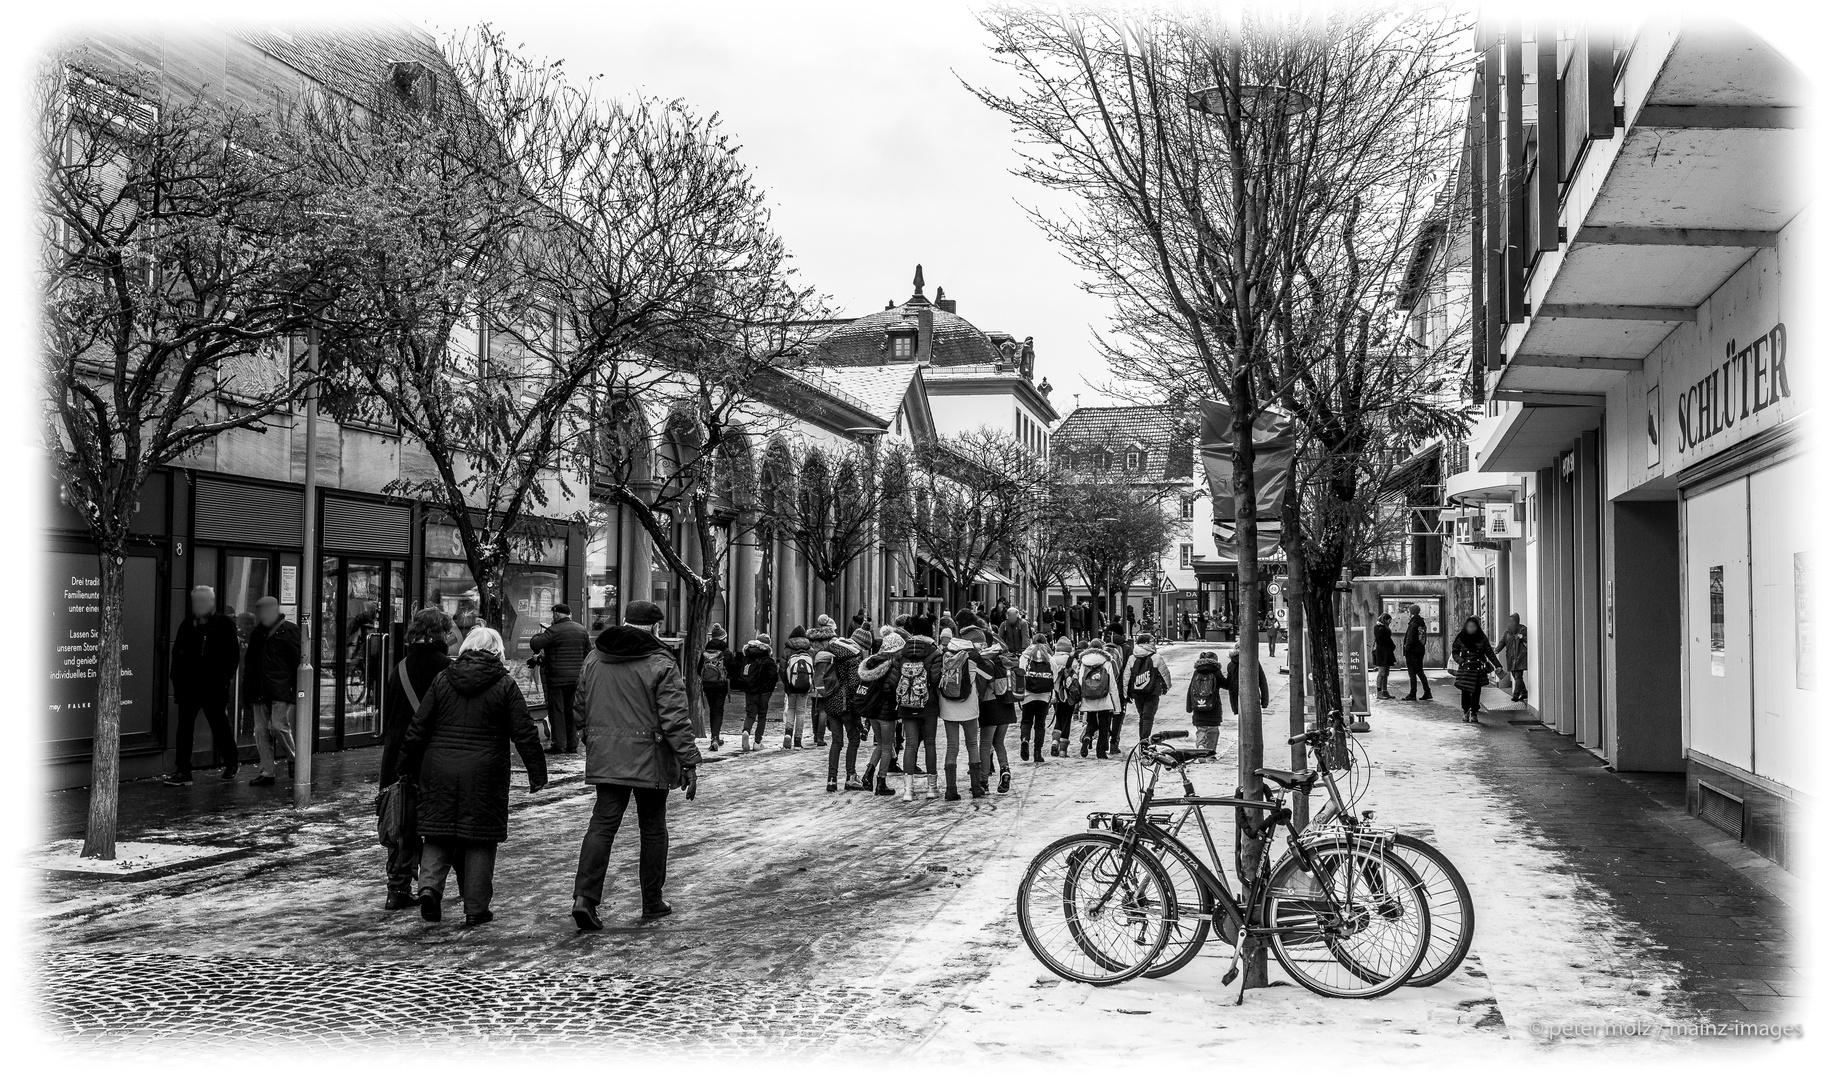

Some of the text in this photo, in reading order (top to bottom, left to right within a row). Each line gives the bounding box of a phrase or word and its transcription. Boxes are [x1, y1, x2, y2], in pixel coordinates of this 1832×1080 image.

[1678, 322, 1791, 454] SCHLÜTER
[176, 542, 183, 556] 8
[71, 576, 84, 586] Drei
[68, 604, 85, 613] unter
[69, 629, 90, 639] Lassen
[56, 644, 82, 653] unserem
[64, 654, 98, 668] und genieß
[49, 668, 87, 680] individuelles
[1135, 670, 1151, 686] NIKE
[67, 702, 91, 710] FALKE
[1161, 837, 1199, 870] SPARTA
